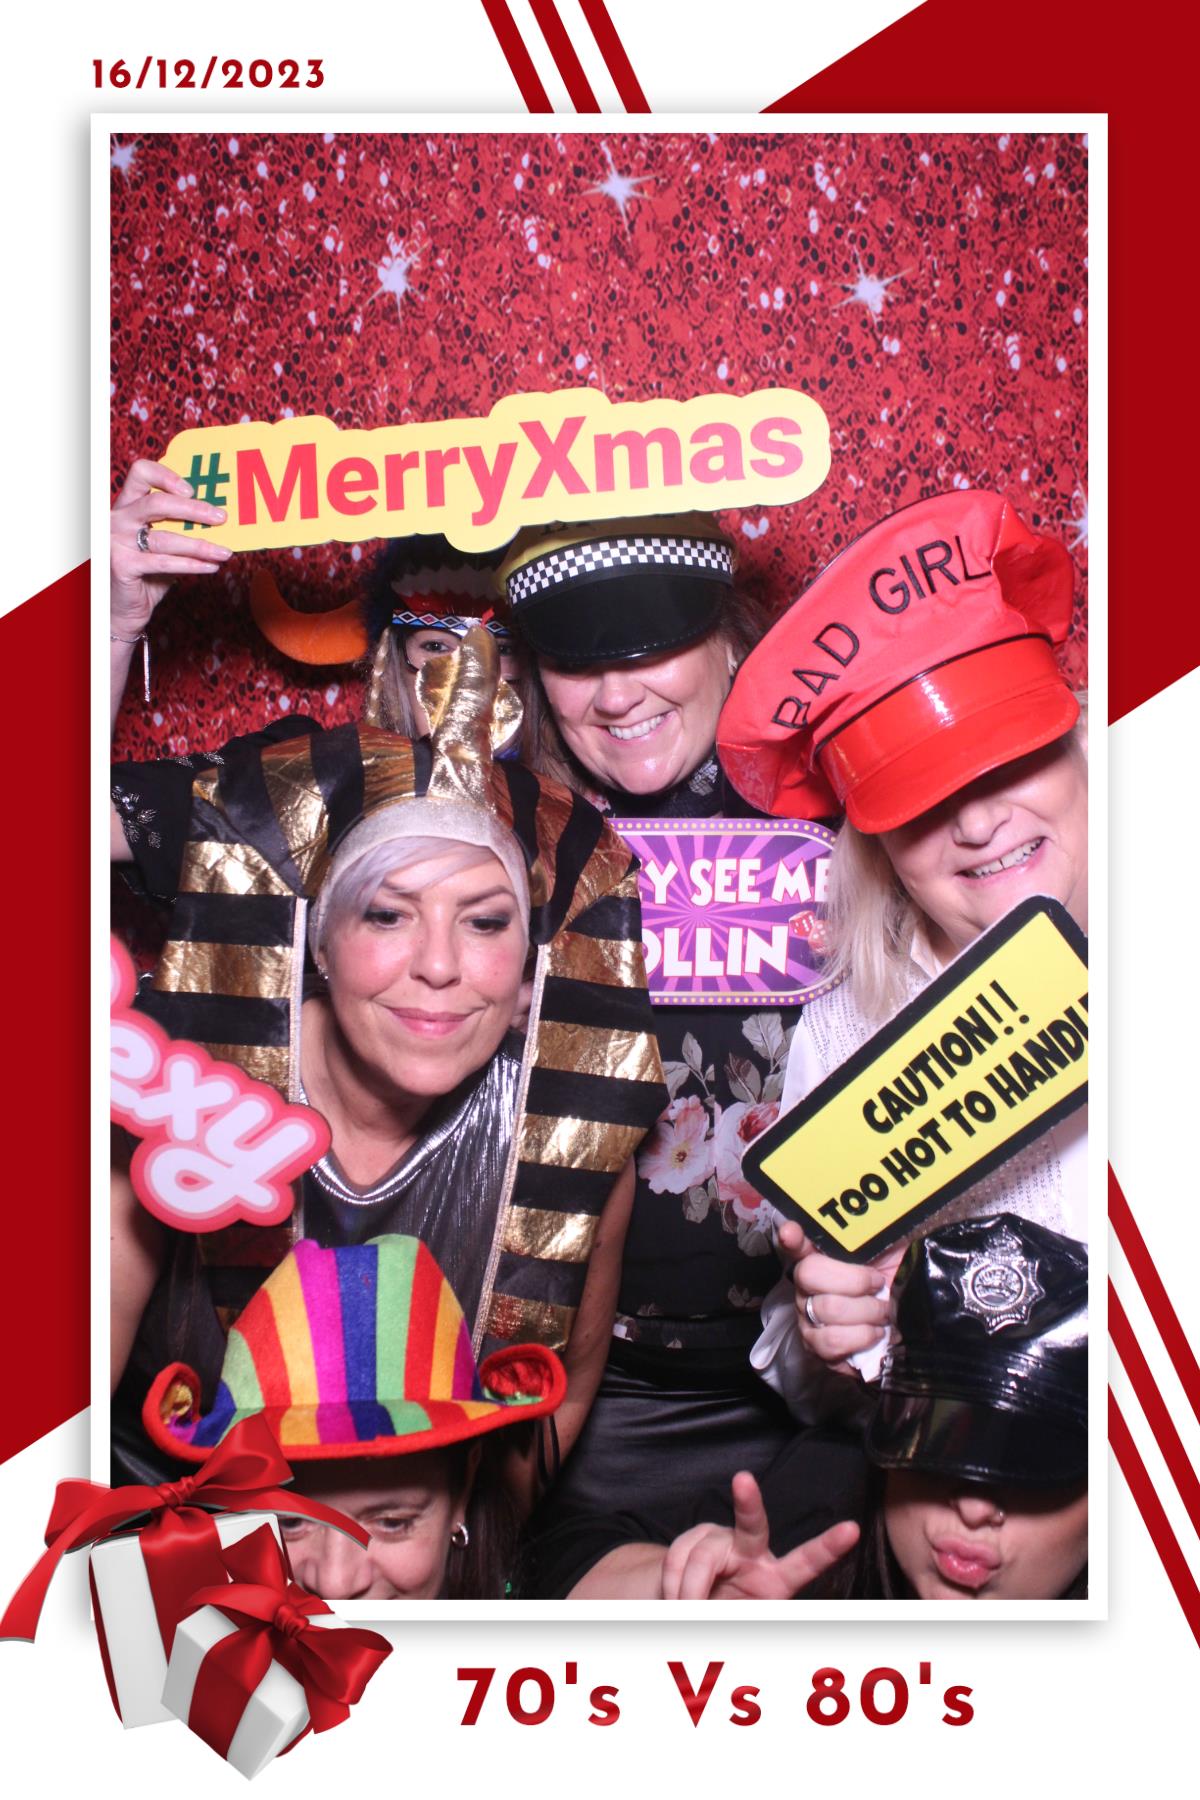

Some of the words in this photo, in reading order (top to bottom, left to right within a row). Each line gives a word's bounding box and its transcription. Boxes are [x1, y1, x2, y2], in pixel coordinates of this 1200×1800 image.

[183, 416, 804, 531] #MerryXmas
[772, 622, 860, 730] BAD
[869, 535, 992, 615] GIRL
[690, 858, 761, 906] SEE
[110, 952, 309, 1214] exy
[817, 1173, 889, 1230] TOO
[880, 1117, 953, 1188] HOT
[940, 1090, 997, 1138] TO
[984, 992, 1088, 1109] HAND
[862, 979, 1030, 1134] CAUTION!!
